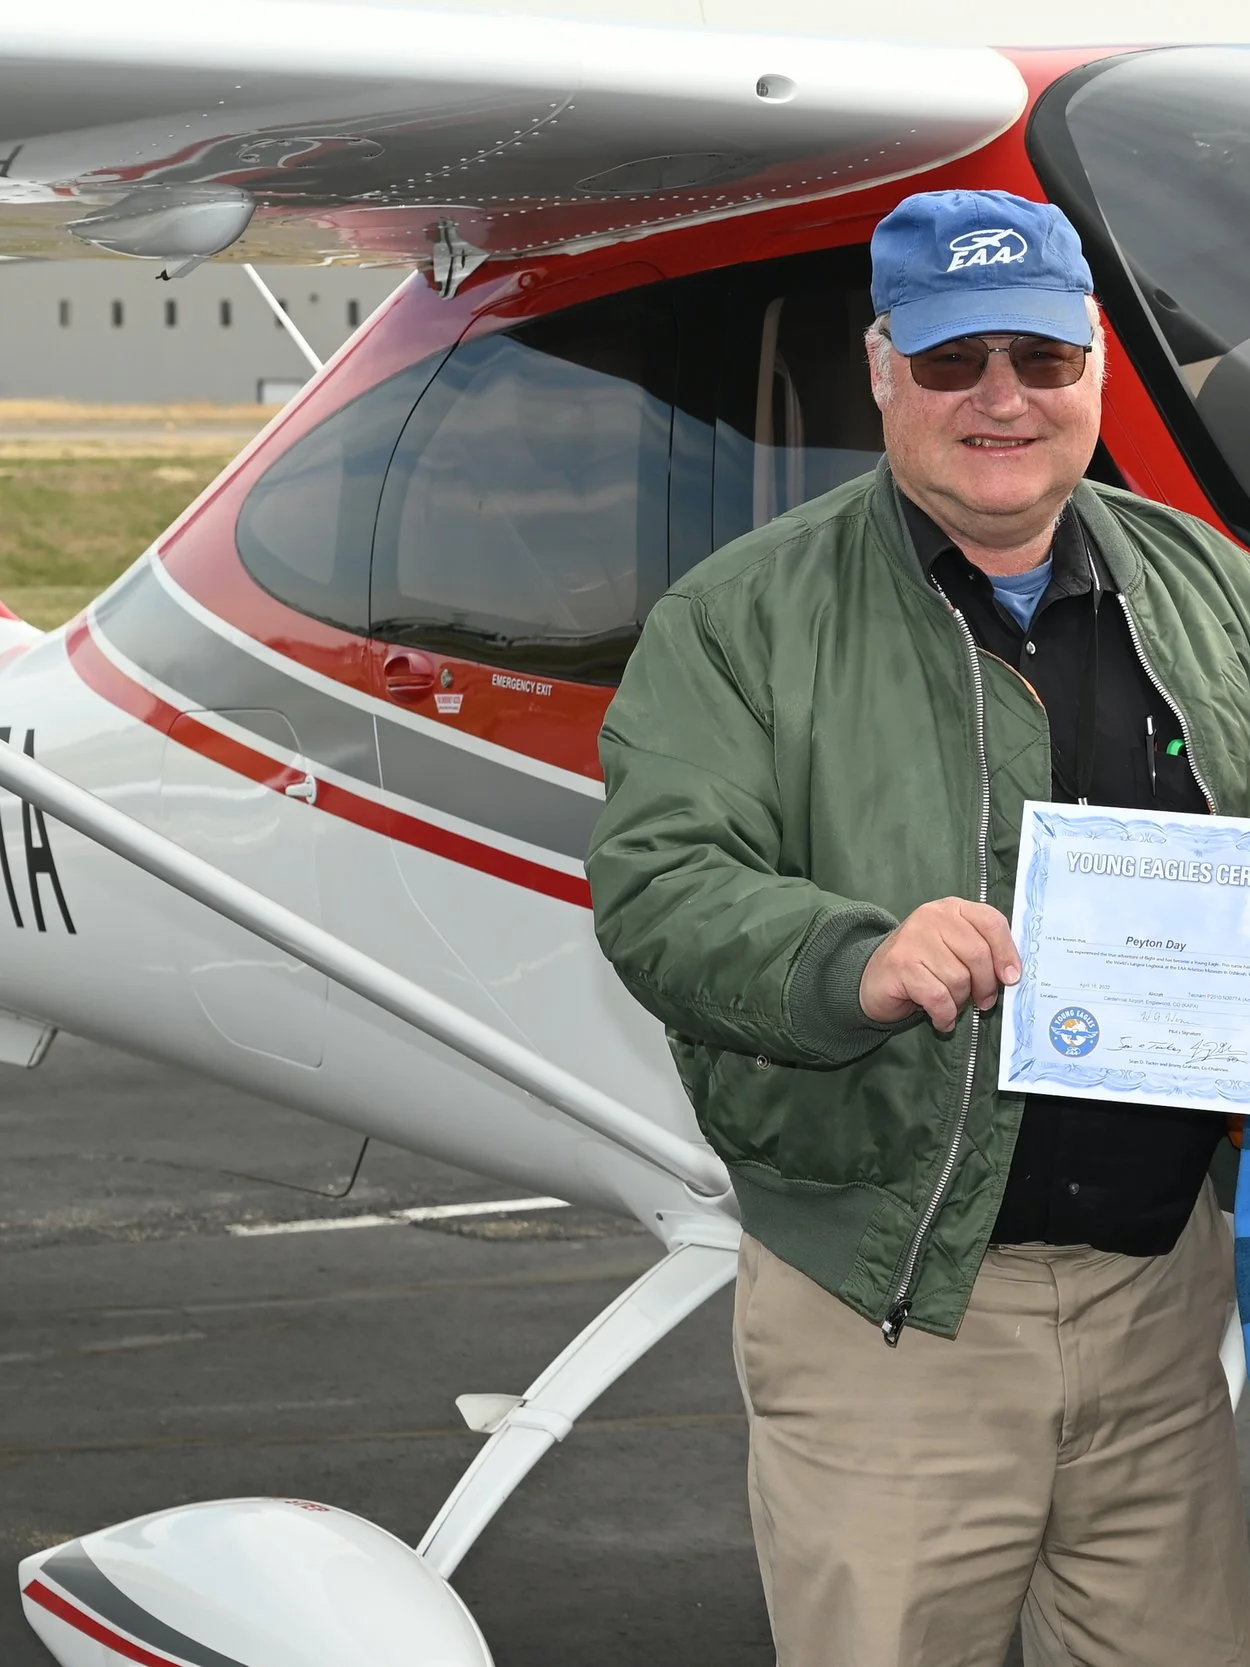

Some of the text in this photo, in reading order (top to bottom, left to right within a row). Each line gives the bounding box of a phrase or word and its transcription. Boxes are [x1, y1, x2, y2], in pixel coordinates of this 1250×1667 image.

[946, 247, 1011, 272] EAA
[491, 673, 553, 696] EMERGENCY EXIT
[1067, 852, 1135, 876] YOUNG
[1139, 858, 1212, 883] EAGLES
[1125, 935, 1186, 952] Peyton Day
[1054, 1007, 1096, 1029] YOUNG EAGLES
